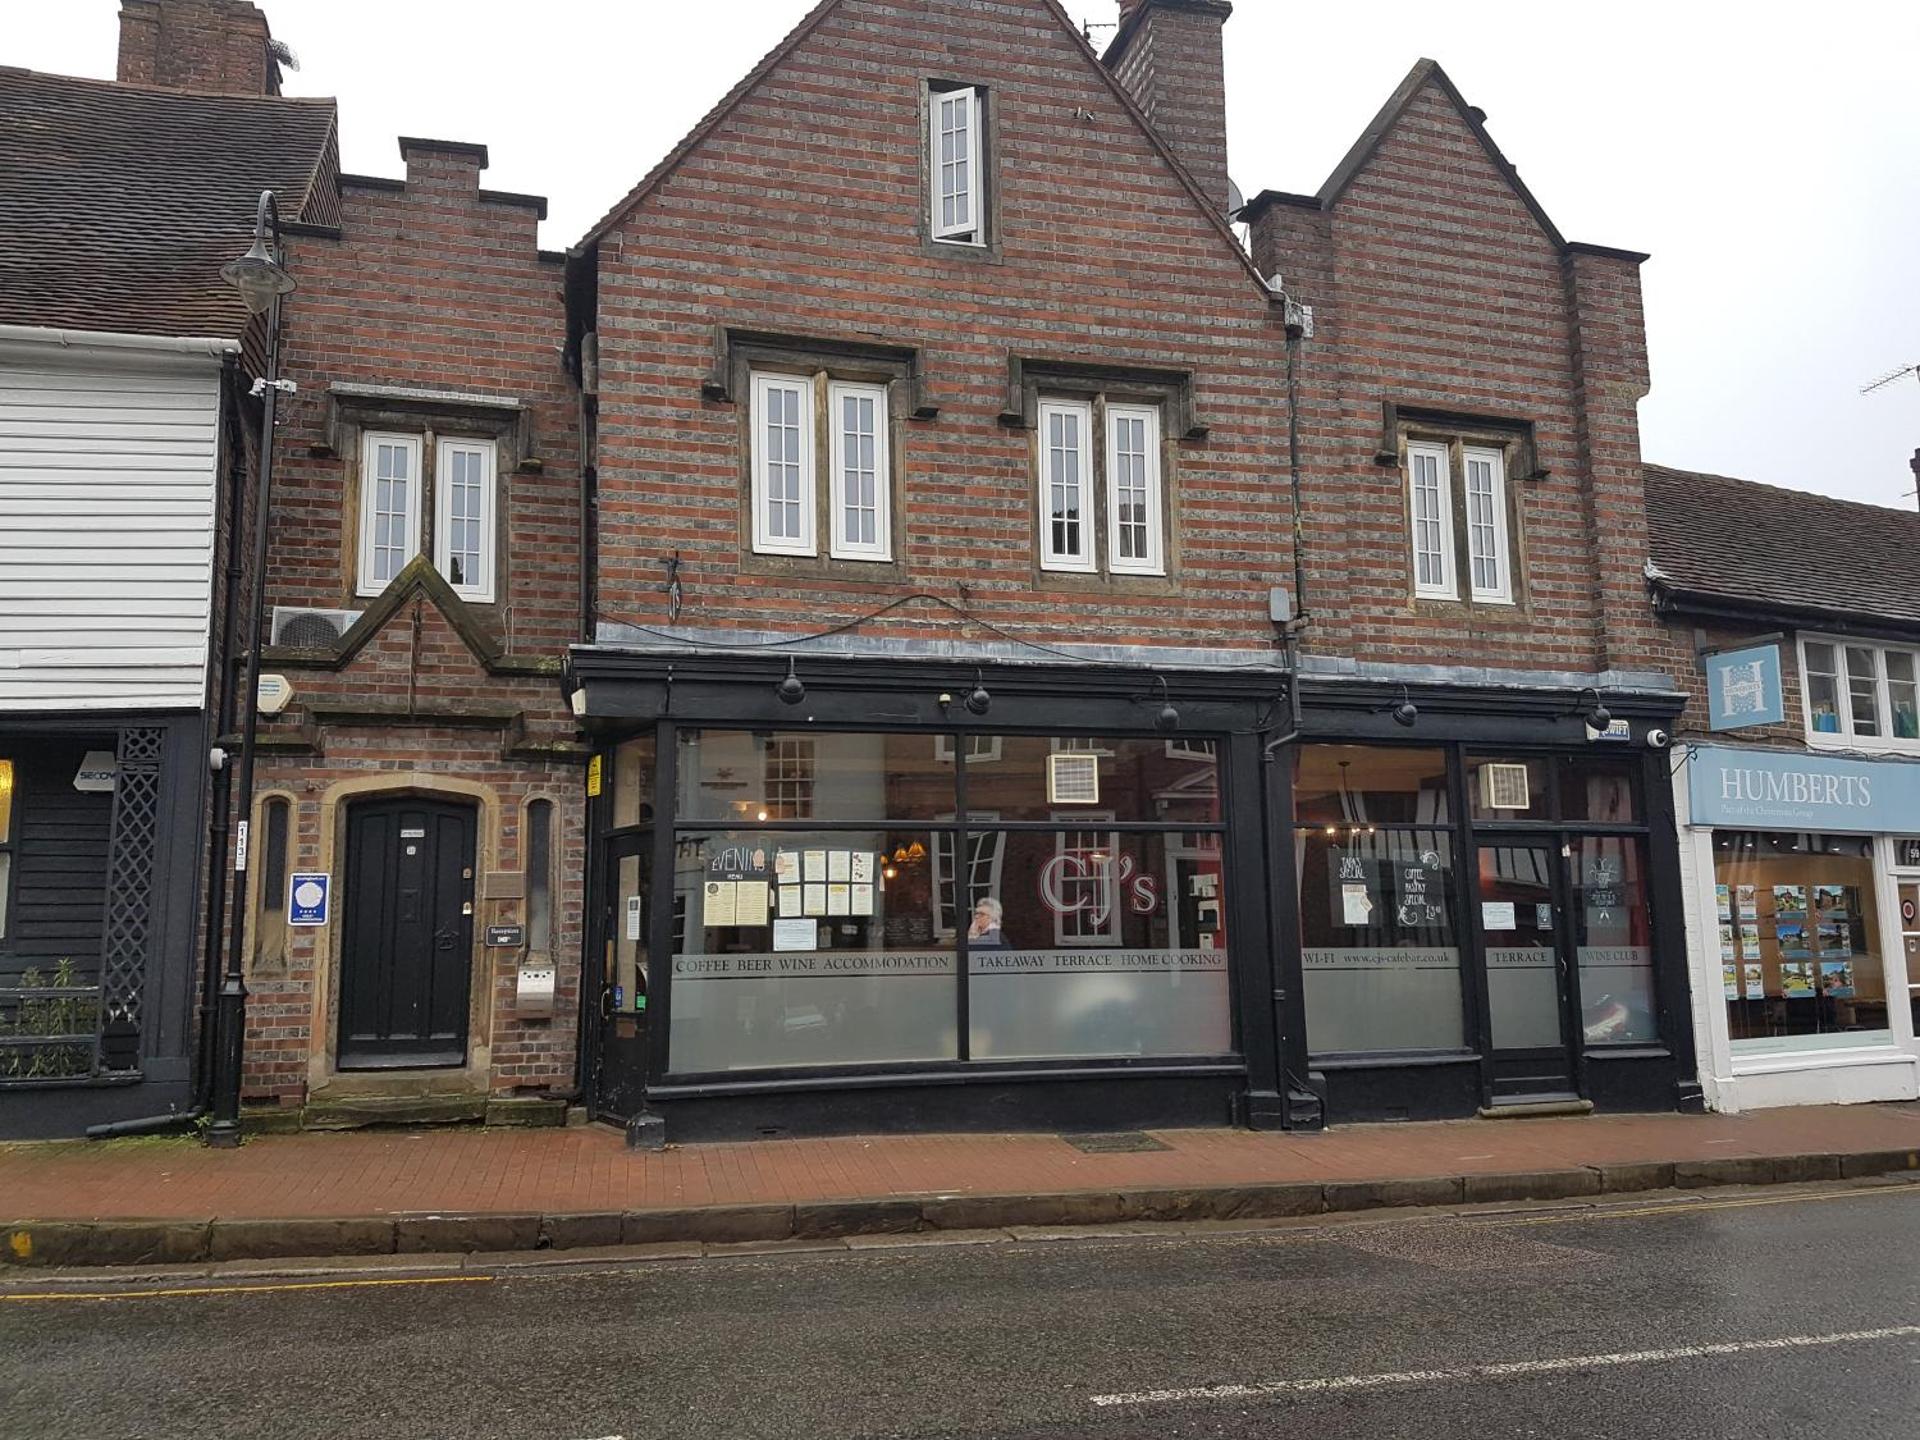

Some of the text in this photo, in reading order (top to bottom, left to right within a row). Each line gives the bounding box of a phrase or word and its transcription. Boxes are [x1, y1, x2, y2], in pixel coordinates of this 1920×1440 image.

[1720, 767, 1871, 807] HUMBERTS
[1040, 855, 1158, 926] CJ's
[978, 954, 1222, 968] TAKEAWAY TERRACE HOME COOKING
[1303, 953, 1335, 964] WI-FI
[1494, 951, 1548, 963] TERRACE
[1585, 950, 1639, 962] WINE CLUB
[675, 956, 950, 973] COFFEE BEER WINE ACCOMMODATION
